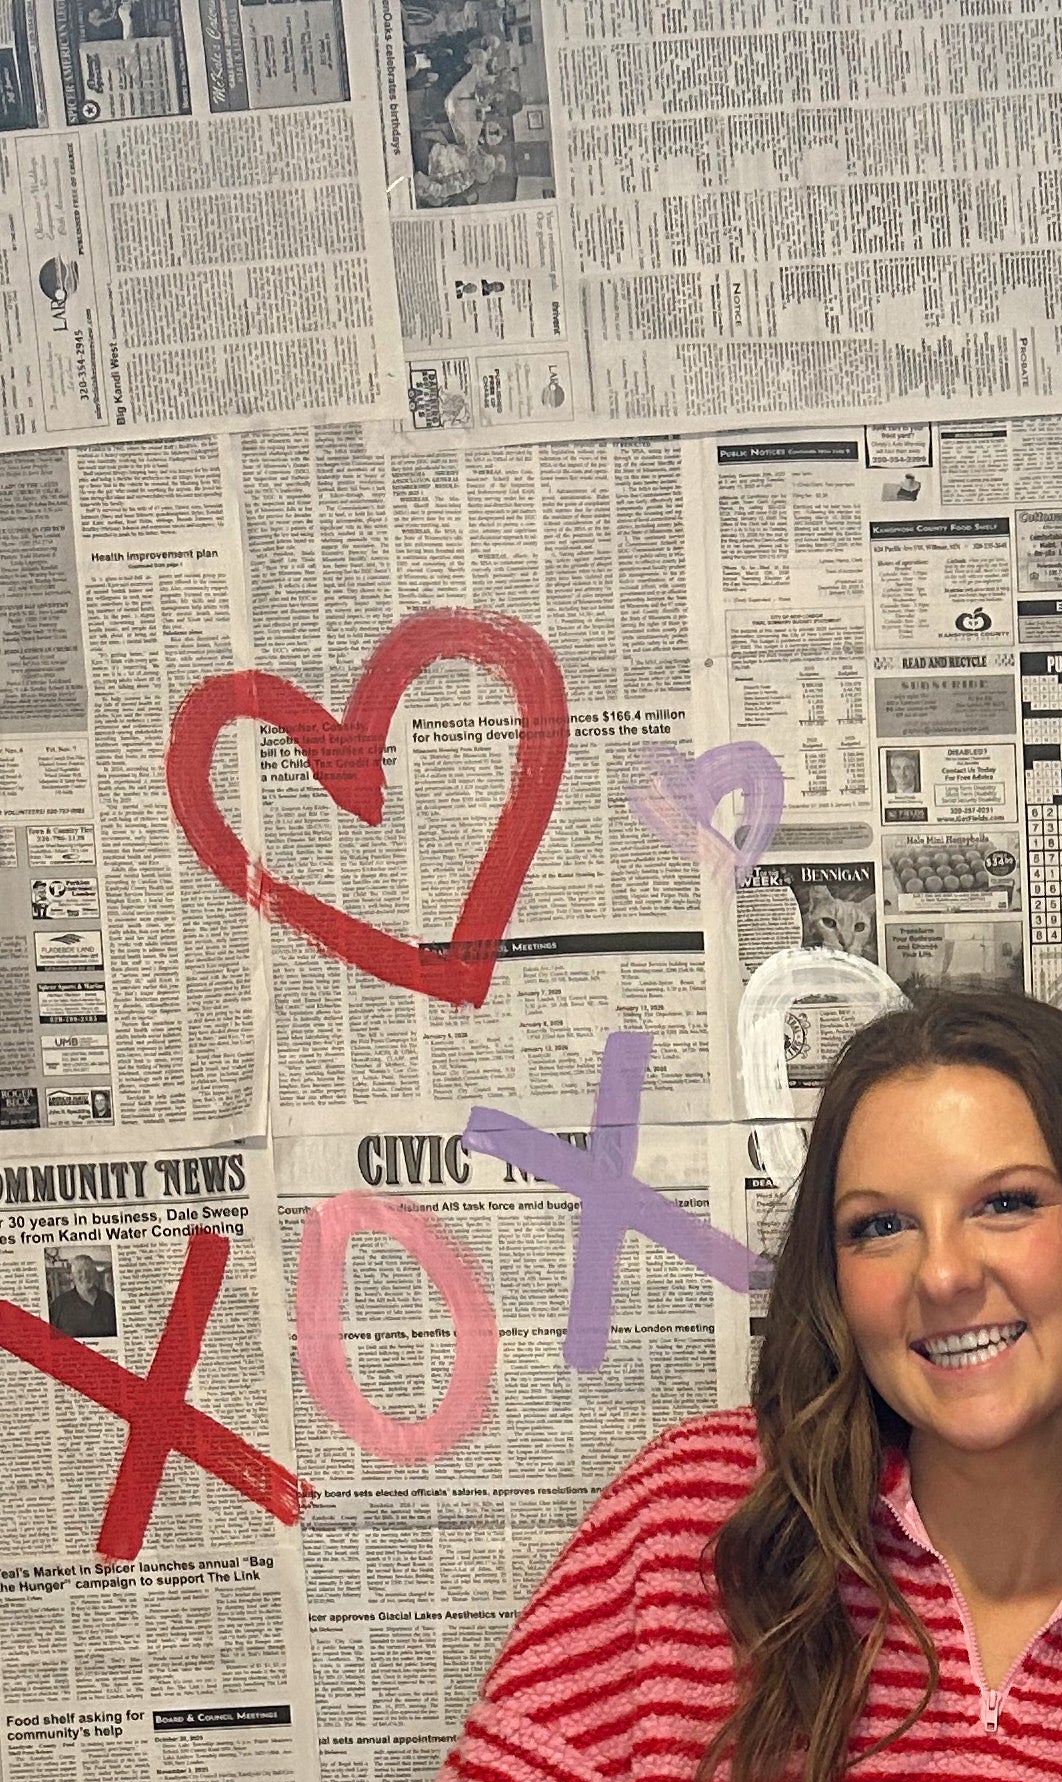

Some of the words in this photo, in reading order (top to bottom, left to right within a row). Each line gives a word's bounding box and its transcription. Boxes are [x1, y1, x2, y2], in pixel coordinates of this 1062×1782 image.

[385, 44, 400, 101] celebrates
[389, 103, 403, 156] birthdays
[108, 342, 119, 369] West
[110, 371, 122, 404] Kandi
[115, 406, 127, 426] Big
[719, 449, 747, 457] PUBLIC
[749, 448, 789, 456] NOTICES
[91, 552, 124, 562] Health
[126, 549, 193, 562] improvement
[195, 548, 218, 560] plan
[901, 656, 926, 669] READ
[927, 656, 947, 668] AND
[948, 655, 987, 667] RECYCLE
[412, 717, 474, 730] Minnesota
[478, 715, 529, 730] Housing
[601, 709, 641, 722] $166.4
[644, 708, 685, 720] million
[412, 731, 430, 743] for
[433, 728, 483, 744] housing
[574, 726, 615, 737] across
[618, 724, 637, 736] the
[641, 723, 671, 735] state
[801, 867, 869, 881] BENNIGAN
[357, 1134, 471, 1187] CIVIC
[154, 1153, 246, 1197] NEWS
[441, 1201, 460, 1211] AIS
[461, 1201, 485, 1211] task
[487, 1200, 515, 1210] force
[517, 1200, 544, 1210] amid
[546, 1200, 583, 1212] budget
[8, 1216, 25, 1230] 30
[29, 1214, 70, 1231] years
[73, 1212, 87, 1225] in
[91, 1211, 161, 1224] business,
[166, 1207, 198, 1221] Dale
[202, 1205, 248, 1219] Sweep
[20, 1231, 54, 1244] from
[58, 1228, 101, 1241] Kandi
[105, 1227, 147, 1240] Water
[151, 1222, 243, 1239] Conditioning
[0, 1566, 30, 1580] eal's
[33, 1565, 76, 1577] Market
[79, 1564, 91, 1575] in
[94, 1560, 135, 1576] Spicer
[138, 1560, 195, 1572] launches
[198, 1556, 239, 1569] annual
[0, 1582, 15, 1592] he
[74, 1576, 136, 1590] campaign
[139, 1575, 153, 1586] to
[156, 1573, 204, 1587] support
[206, 1571, 230, 1582] The
[233, 1569, 260, 1581] Link
[6, 1714, 39, 1726] Food
[42, 1712, 75, 1725] shelf
[78, 1711, 122, 1724] asking
[125, 1709, 144, 1721] for
[6, 1726, 90, 1740] community's
[94, 1722, 123, 1738] help
